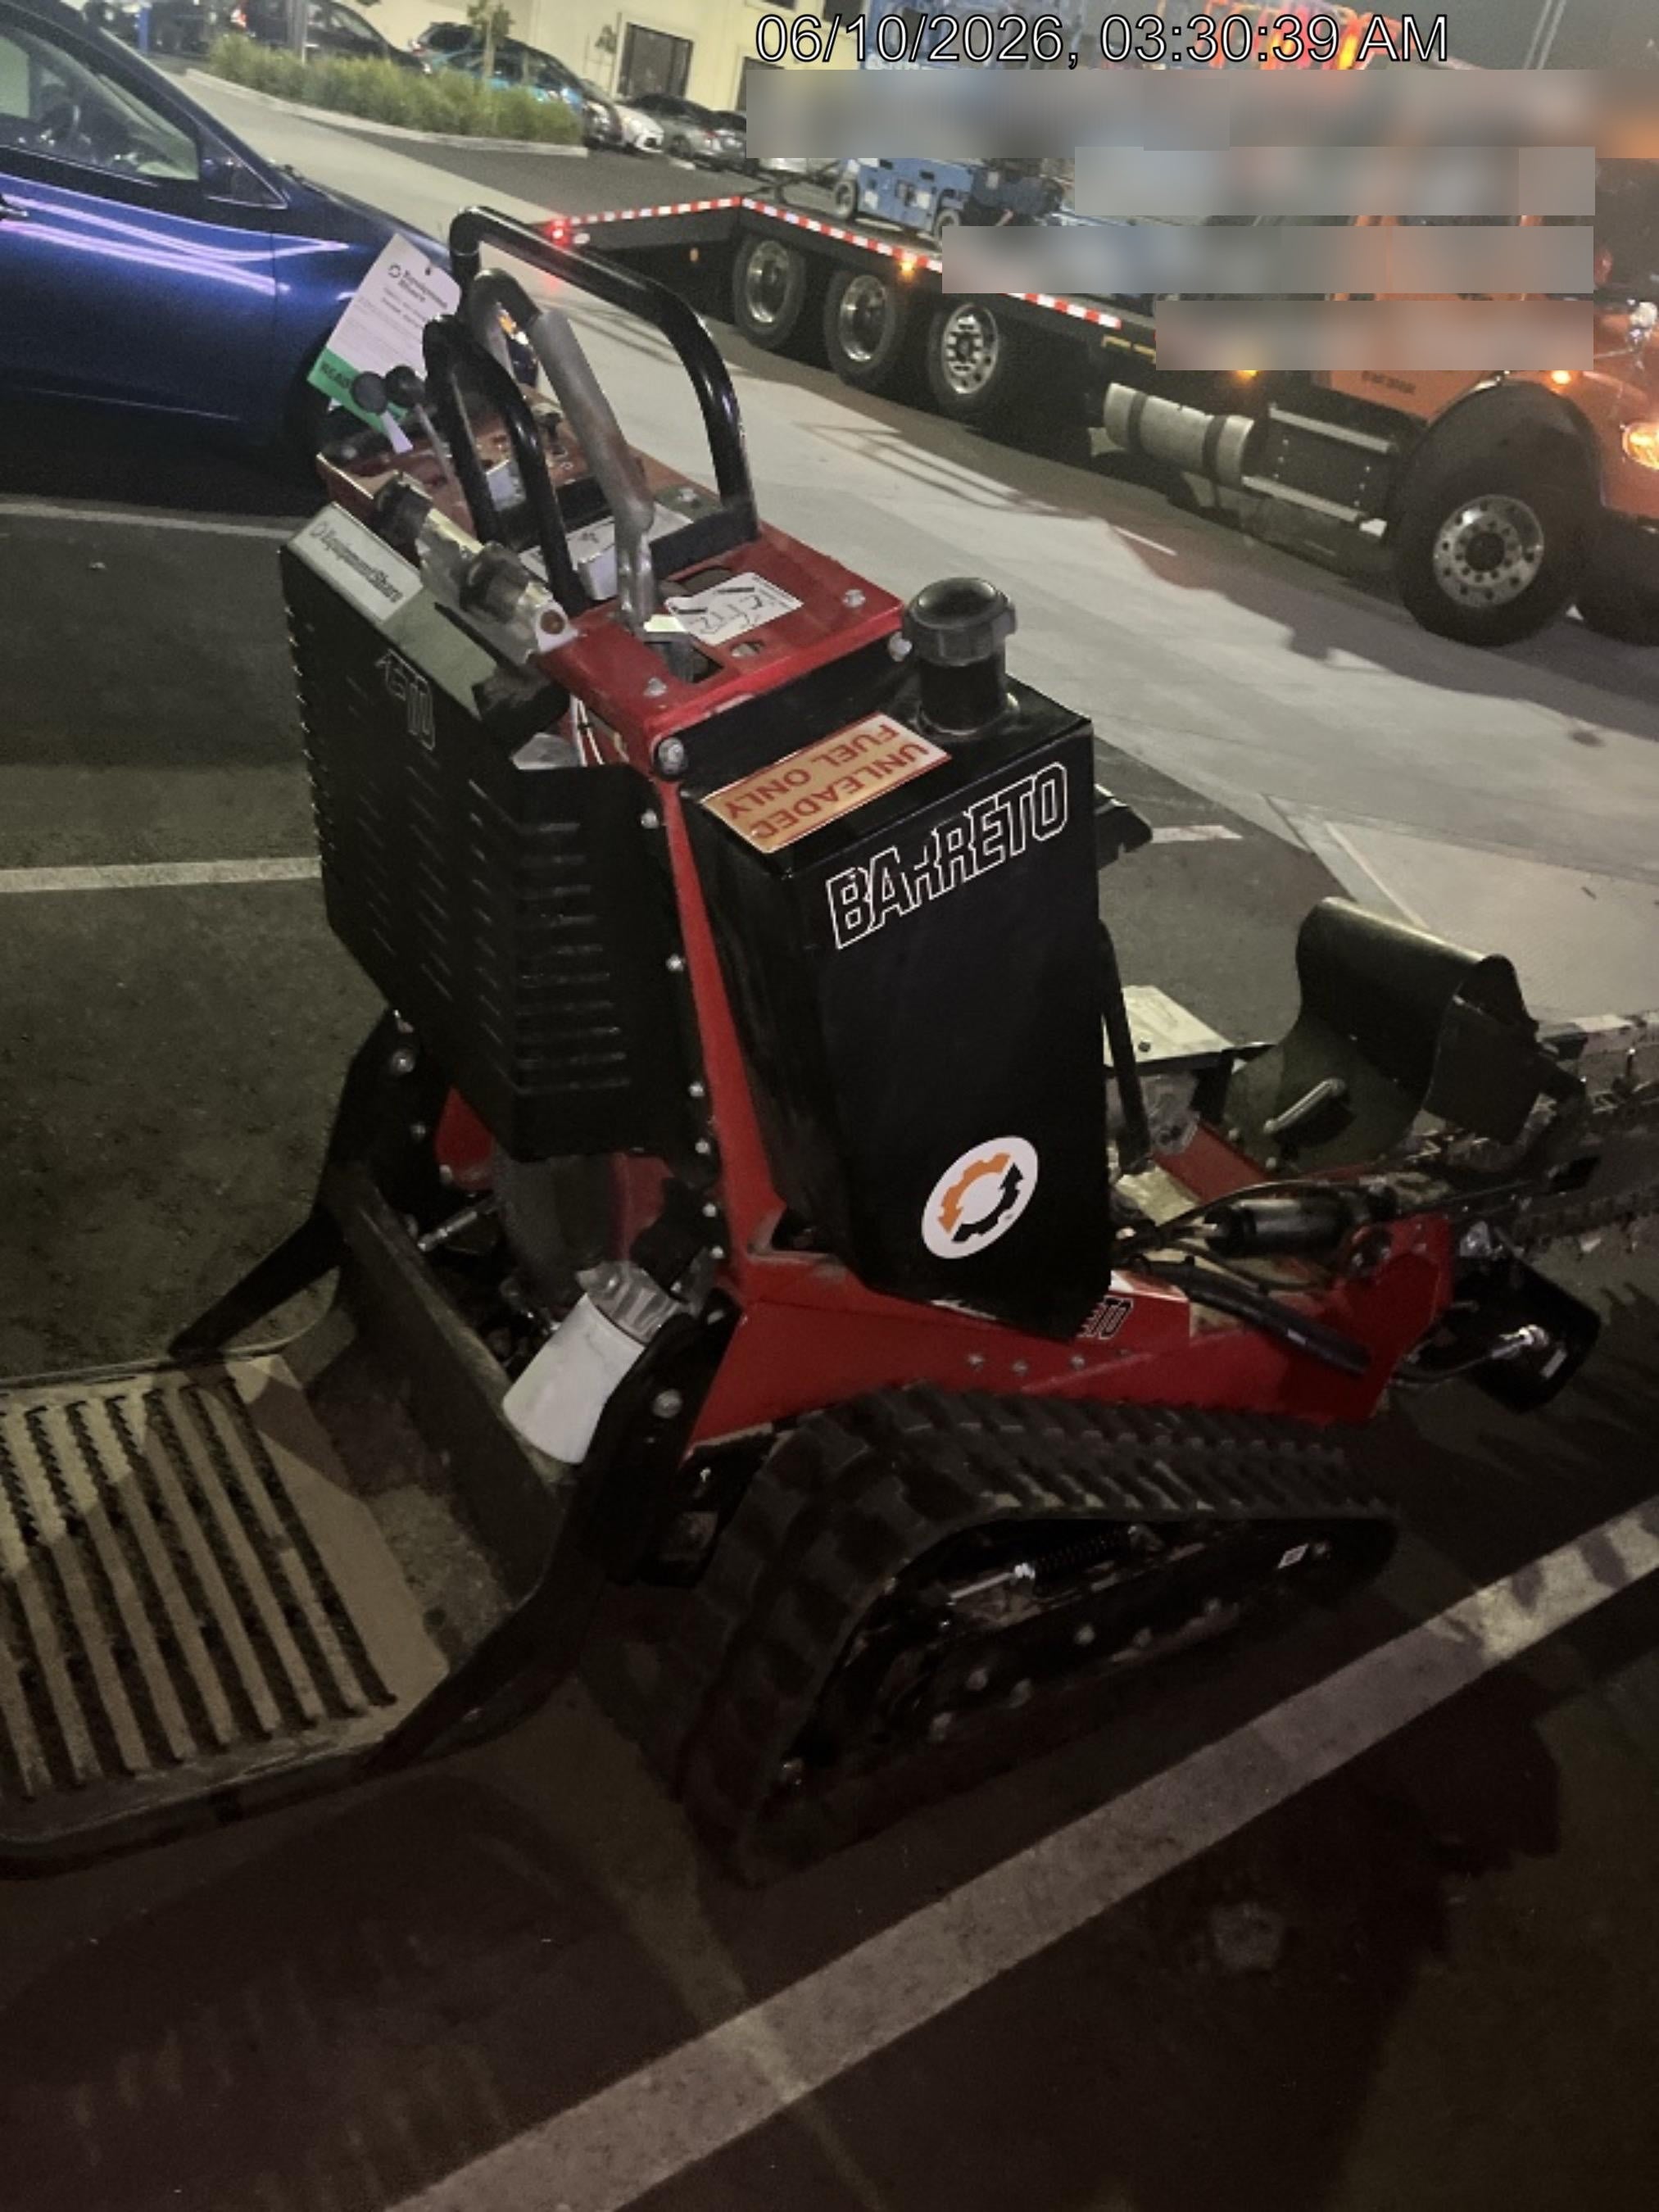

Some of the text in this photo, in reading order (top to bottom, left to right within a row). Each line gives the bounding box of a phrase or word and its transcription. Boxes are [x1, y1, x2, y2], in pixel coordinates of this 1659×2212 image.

[724, 723, 900, 819] FUEL ONLY
[749, 742, 929, 840] UNLEADED
